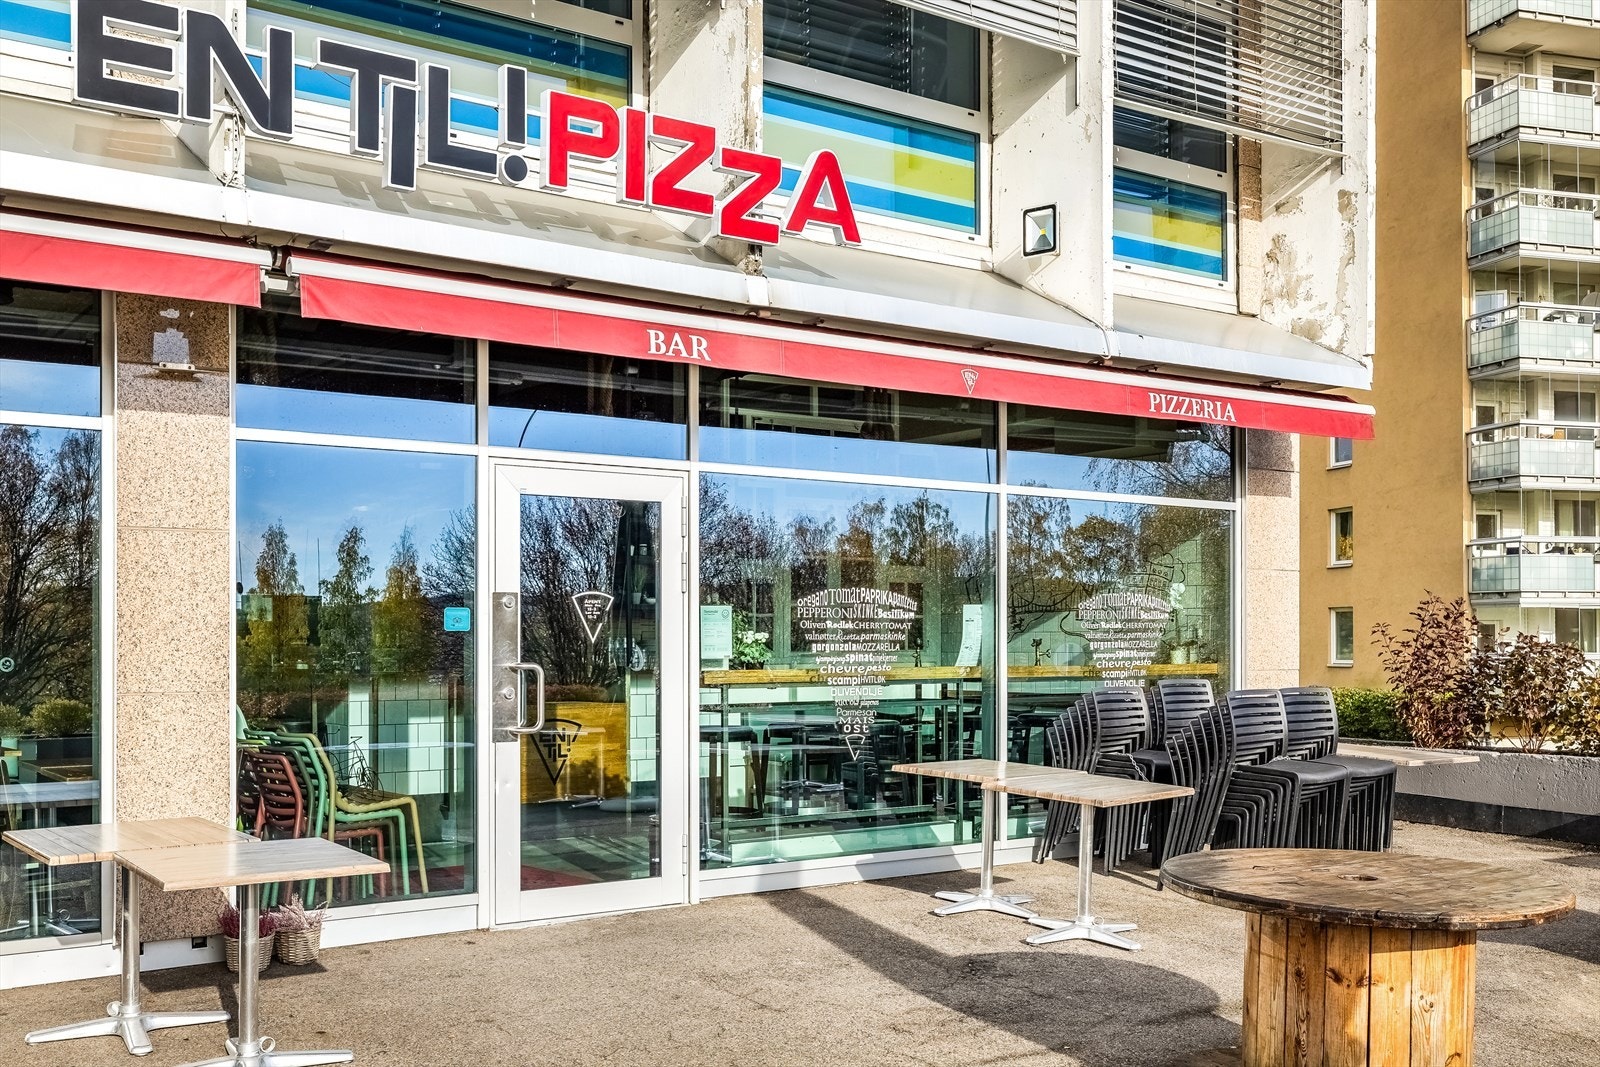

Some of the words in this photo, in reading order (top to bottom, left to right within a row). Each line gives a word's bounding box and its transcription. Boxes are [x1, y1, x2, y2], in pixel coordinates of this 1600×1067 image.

[73, 0, 295, 141] EN
[540, 89, 862, 246] PIZZA
[646, 329, 712, 362] BAR
[1148, 392, 1236, 423] PIZZERIA
[861, 588, 892, 605] PAPRIKA
[797, 607, 853, 618] PEPPERONI
[800, 620, 826, 629] Oliven
[854, 621, 912, 630] CHERRYTOMAT
[860, 630, 906, 642] parmaskinke
[812, 642, 859, 653] gorgonzola
[858, 642, 900, 651] MOZZARELLA
[845, 652, 873, 666] spinat
[1116, 648, 1137, 659] spinat
[820, 663, 866, 674] chevre
[865, 663, 892, 676] pesto
[1096, 659, 1132, 669] chevre
[1131, 658, 1152, 670] pesto
[1102, 668, 1128, 679] scampi
[827, 675, 860, 686] scampi
[831, 687, 883, 697] OLIVENOLJE
[836, 707, 878, 717] Parmesan
[838, 716, 875, 725] MAIS
